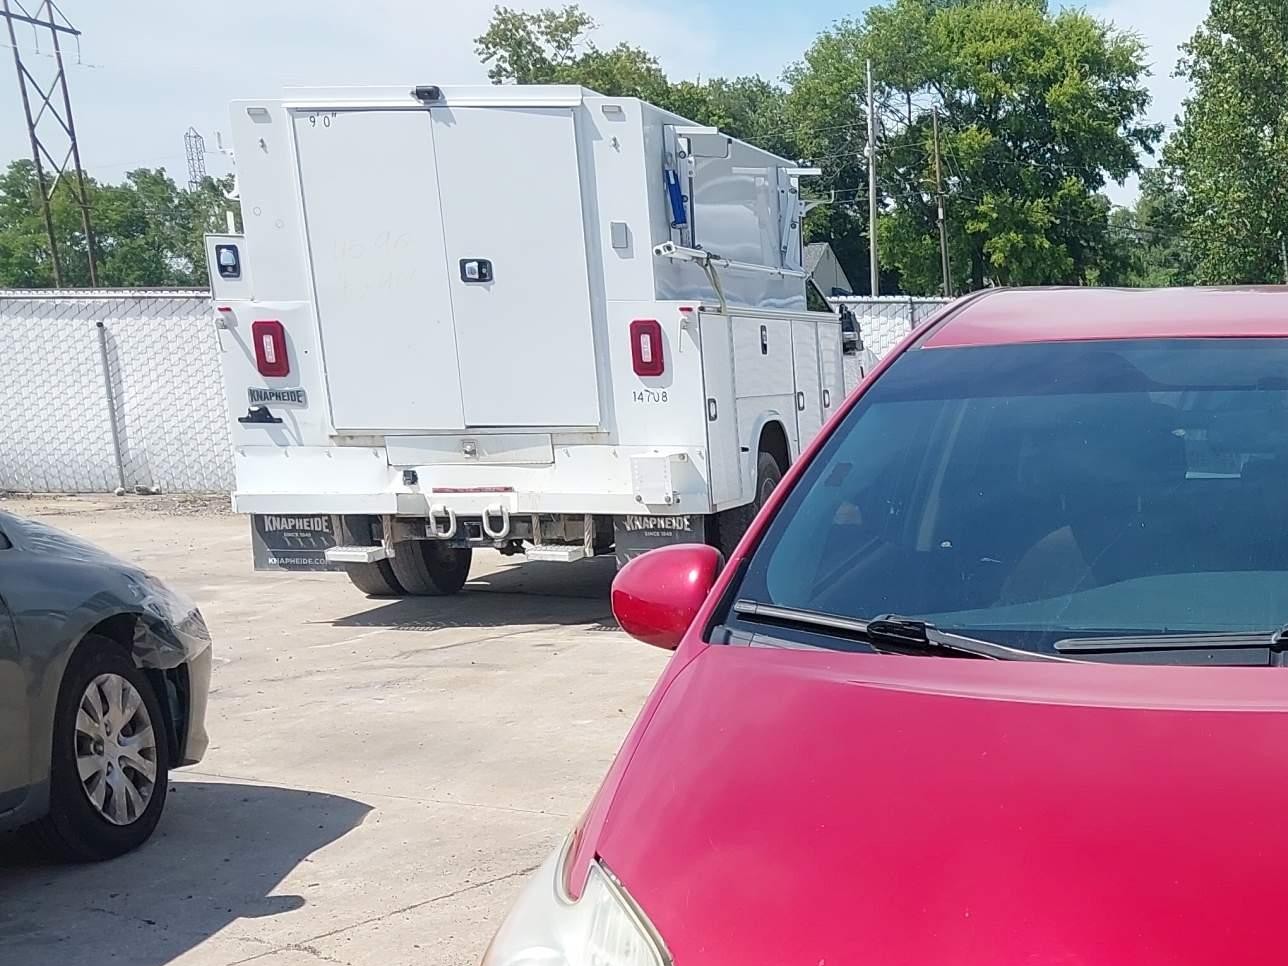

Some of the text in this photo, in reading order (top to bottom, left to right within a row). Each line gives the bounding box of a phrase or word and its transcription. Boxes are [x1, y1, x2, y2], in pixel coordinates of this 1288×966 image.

[249, 388, 303, 403] KNAPHEIDE
[632, 389, 668, 403] 14708
[264, 515, 330, 533] KNAPHEIDE
[624, 515, 691, 532] KNAPHEIDE
